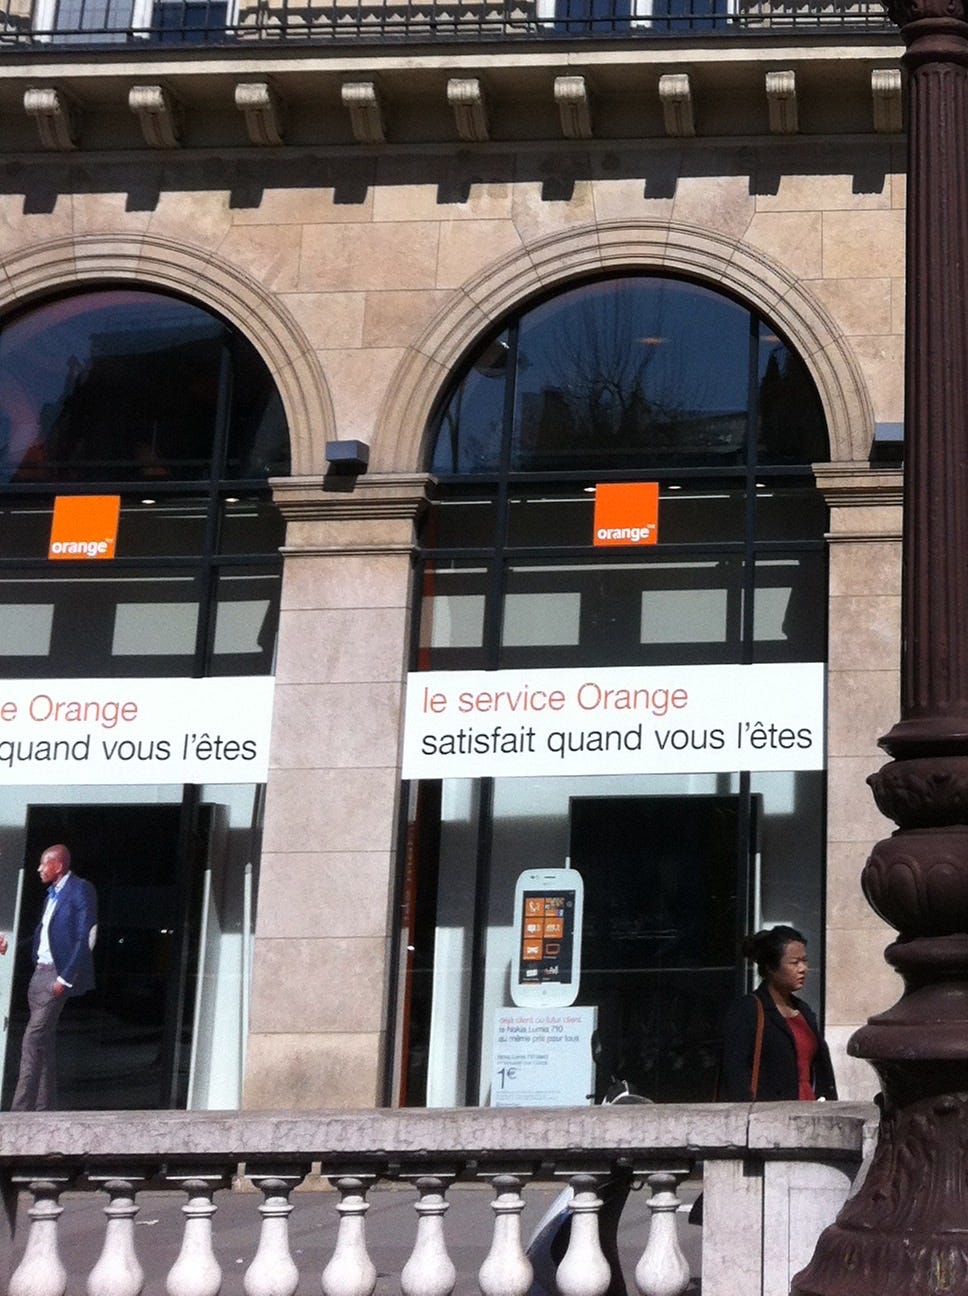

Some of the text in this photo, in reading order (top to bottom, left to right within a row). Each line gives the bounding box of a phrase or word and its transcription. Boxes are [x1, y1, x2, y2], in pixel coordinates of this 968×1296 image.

[51, 541, 108, 557] orange
[597, 527, 650, 542] orange
[29, 694, 138, 729] Orange
[423, 682, 689, 716] le service Orange
[0, 732, 257, 768] quand vous l'êtes
[421, 721, 813, 759] satisfait quand vous l'êtes
